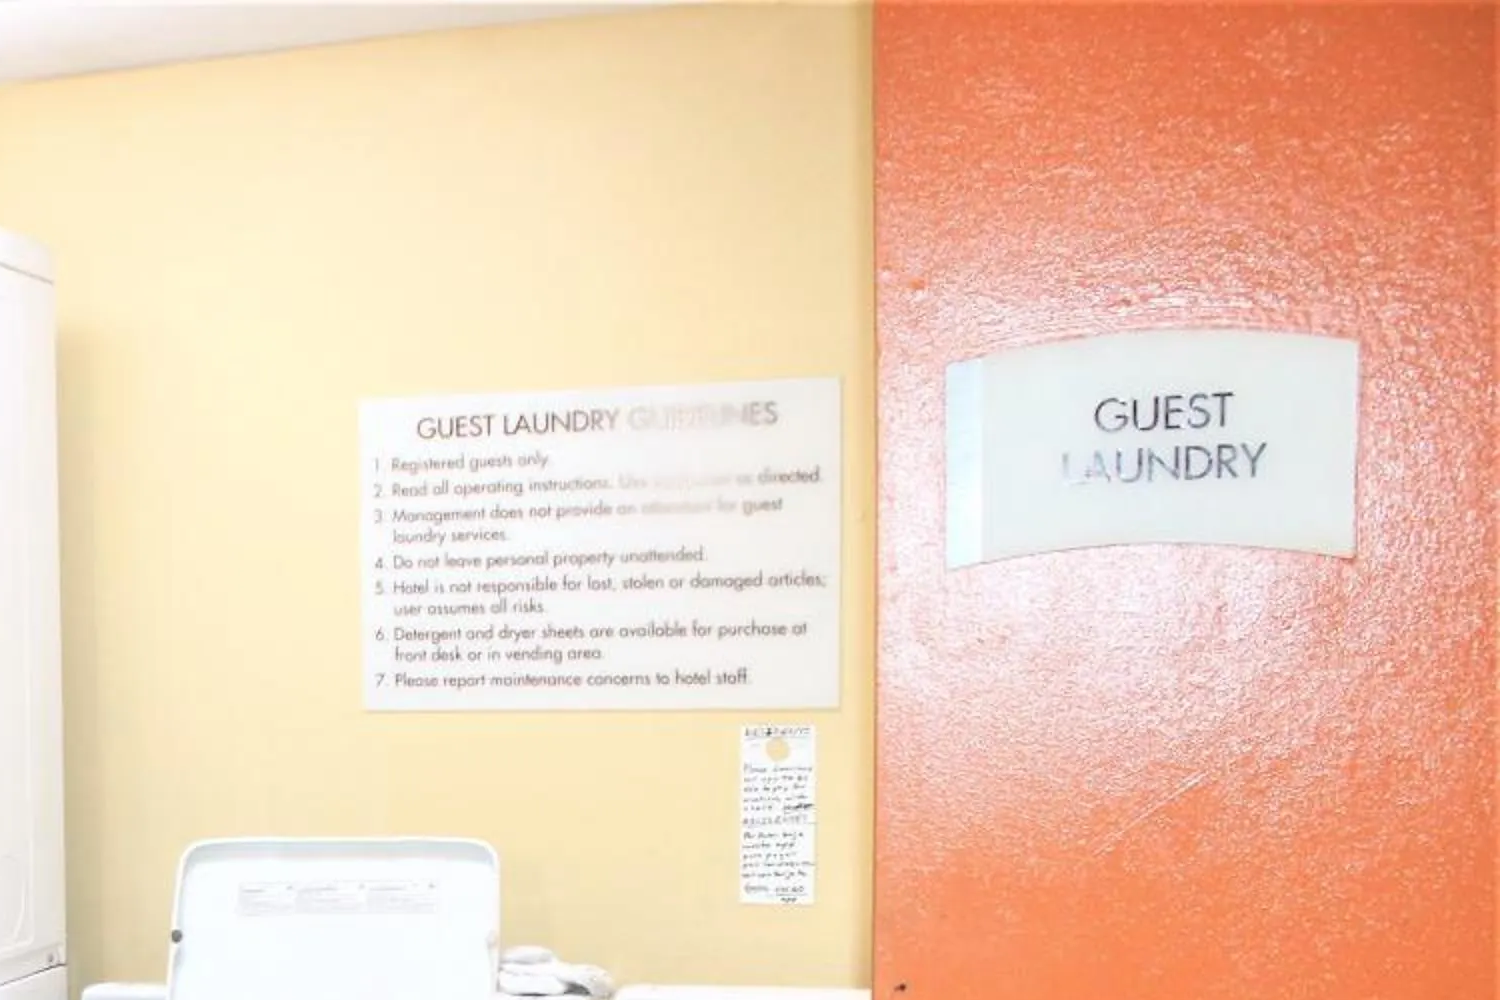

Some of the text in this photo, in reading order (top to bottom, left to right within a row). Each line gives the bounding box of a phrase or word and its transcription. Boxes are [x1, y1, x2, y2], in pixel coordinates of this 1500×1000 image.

[416, 414, 495, 440] GUEST
[503, 407, 620, 436] LAUNDRY
[1093, 392, 1234, 433] GUEST
[391, 453, 465, 474] Registered
[469, 454, 513, 472] guests
[1061, 441, 1268, 485] LAUNDRY
[392, 483, 428, 497] Read
[433, 479, 449, 496] all
[454, 479, 523, 498] operating
[392, 508, 486, 526] Management
[490, 504, 523, 520] does
[529, 504, 552, 517] not
[556, 500, 612, 521] provide
[742, 497, 783, 517] guest
[392, 527, 446, 547] laundry
[392, 554, 414, 569] Do
[417, 553, 440, 568] not
[443, 551, 482, 567] leave
[486, 551, 549, 571] personal
[553, 549, 615, 568] property
[393, 578, 429, 595] Hotel
[434, 582, 445, 594] is
[449, 580, 473, 593] not
[477, 575, 559, 599] responsible
[562, 574, 583, 592] for
[622, 573, 665, 590] stolen
[669, 576, 683, 589] or
[689, 570, 763, 592] damaged
[393, 602, 423, 616] user
[427, 600, 486, 615] assumes
[489, 598, 508, 614] all
[393, 626, 462, 645] Detergent
[465, 624, 494, 640] and
[497, 624, 536, 643] dryer
[541, 624, 585, 639] sheets
[589, 627, 614, 638] are
[619, 620, 688, 638] available
[691, 619, 713, 636] for
[717, 619, 787, 640] purchase
[791, 622, 808, 634] at
[394, 646, 427, 662] front
[431, 646, 463, 661] desk
[467, 650, 483, 661] or
[487, 646, 501, 660] in
[505, 644, 563, 665] vending
[394, 672, 439, 688] Please
[443, 674, 486, 691] report
[489, 671, 581, 686] maintenance
[585, 671, 651, 686] concerns
[655, 671, 671, 684] to
[675, 666, 711, 684] hotel
